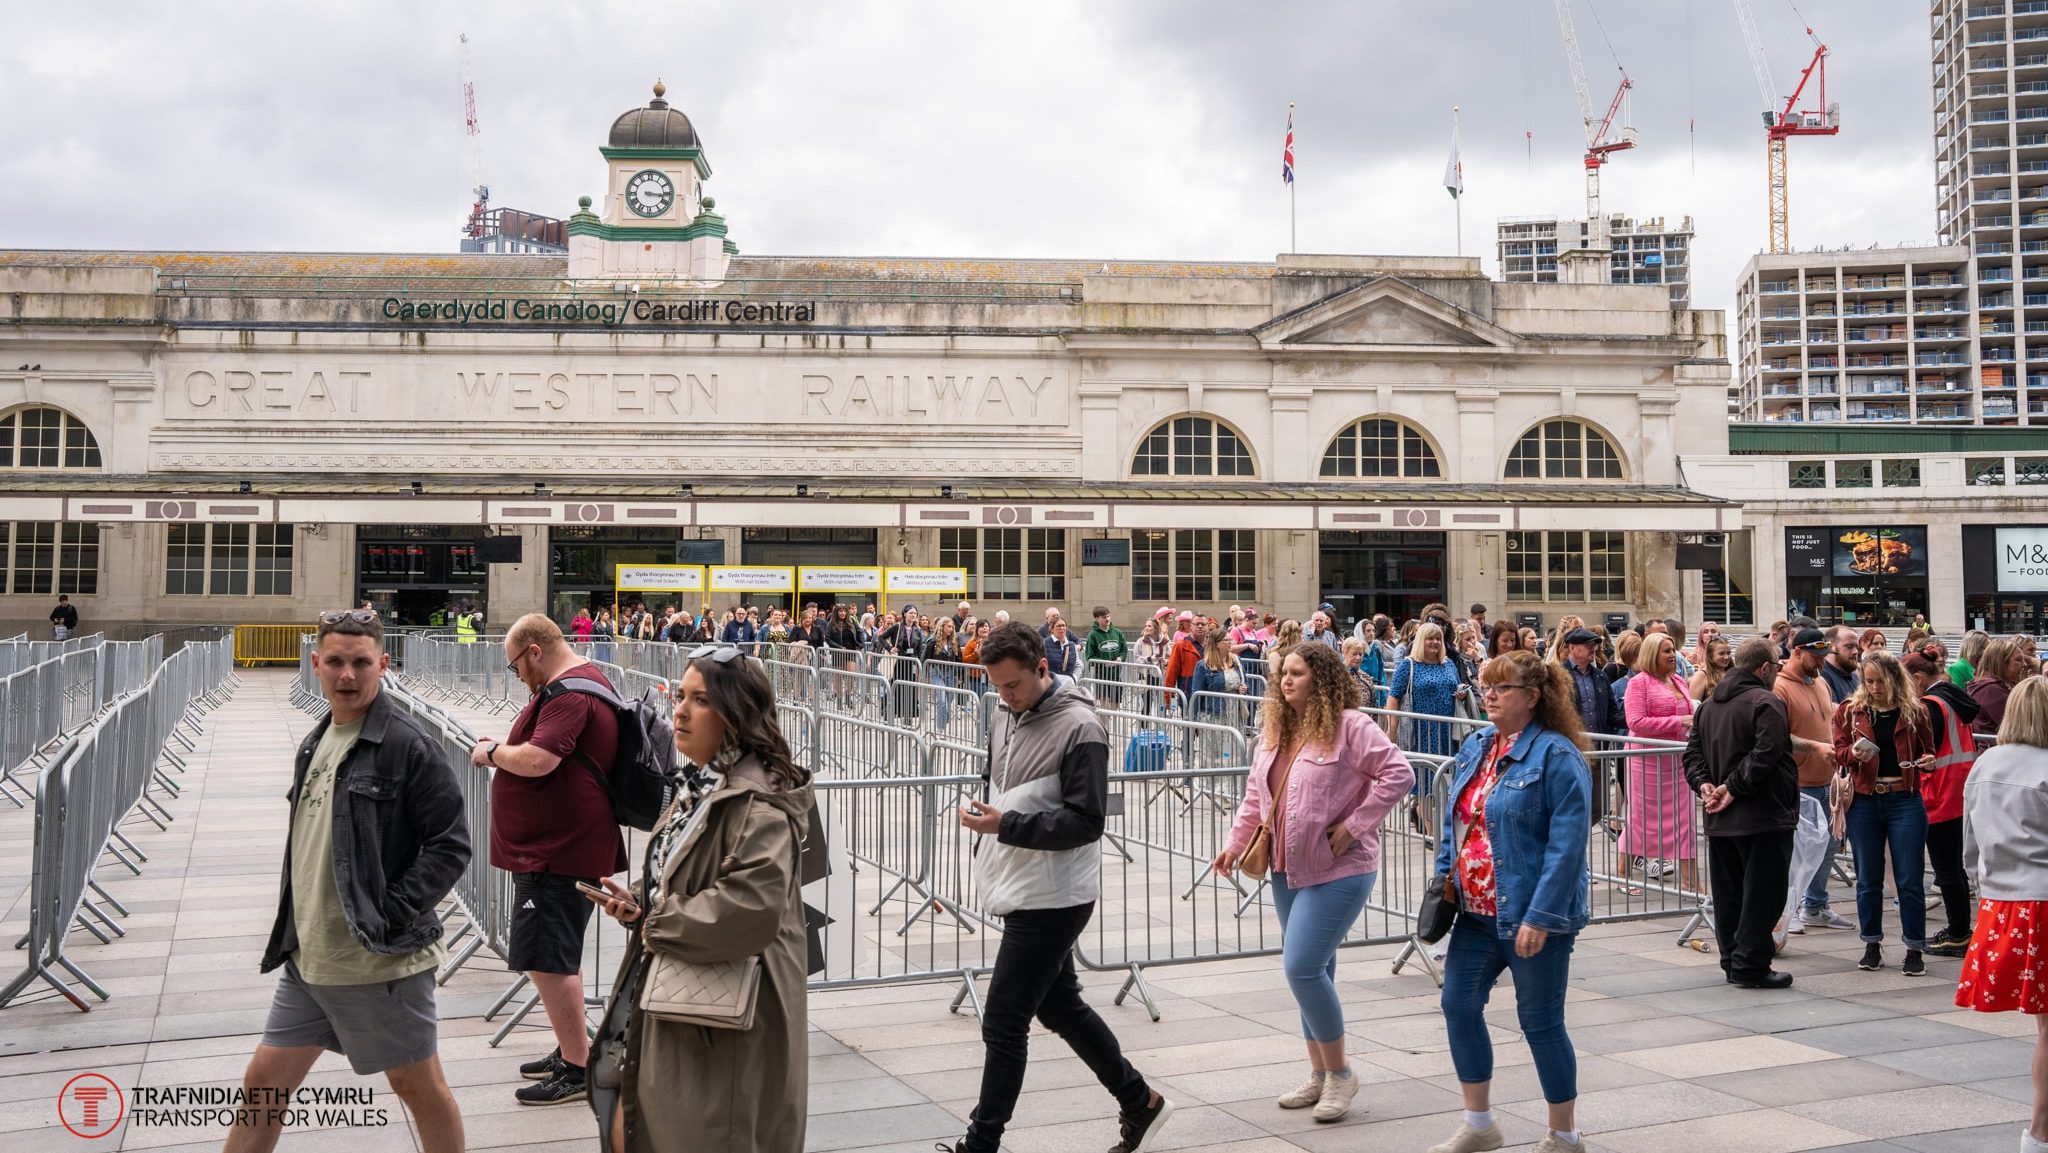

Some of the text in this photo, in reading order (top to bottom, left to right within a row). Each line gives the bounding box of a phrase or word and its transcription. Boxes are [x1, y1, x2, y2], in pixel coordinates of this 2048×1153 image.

[383, 298, 506, 324] Caerdydd
[725, 300, 816, 322] Central
[184, 370, 1052, 417] GREAT WESTERN RAILWAY
